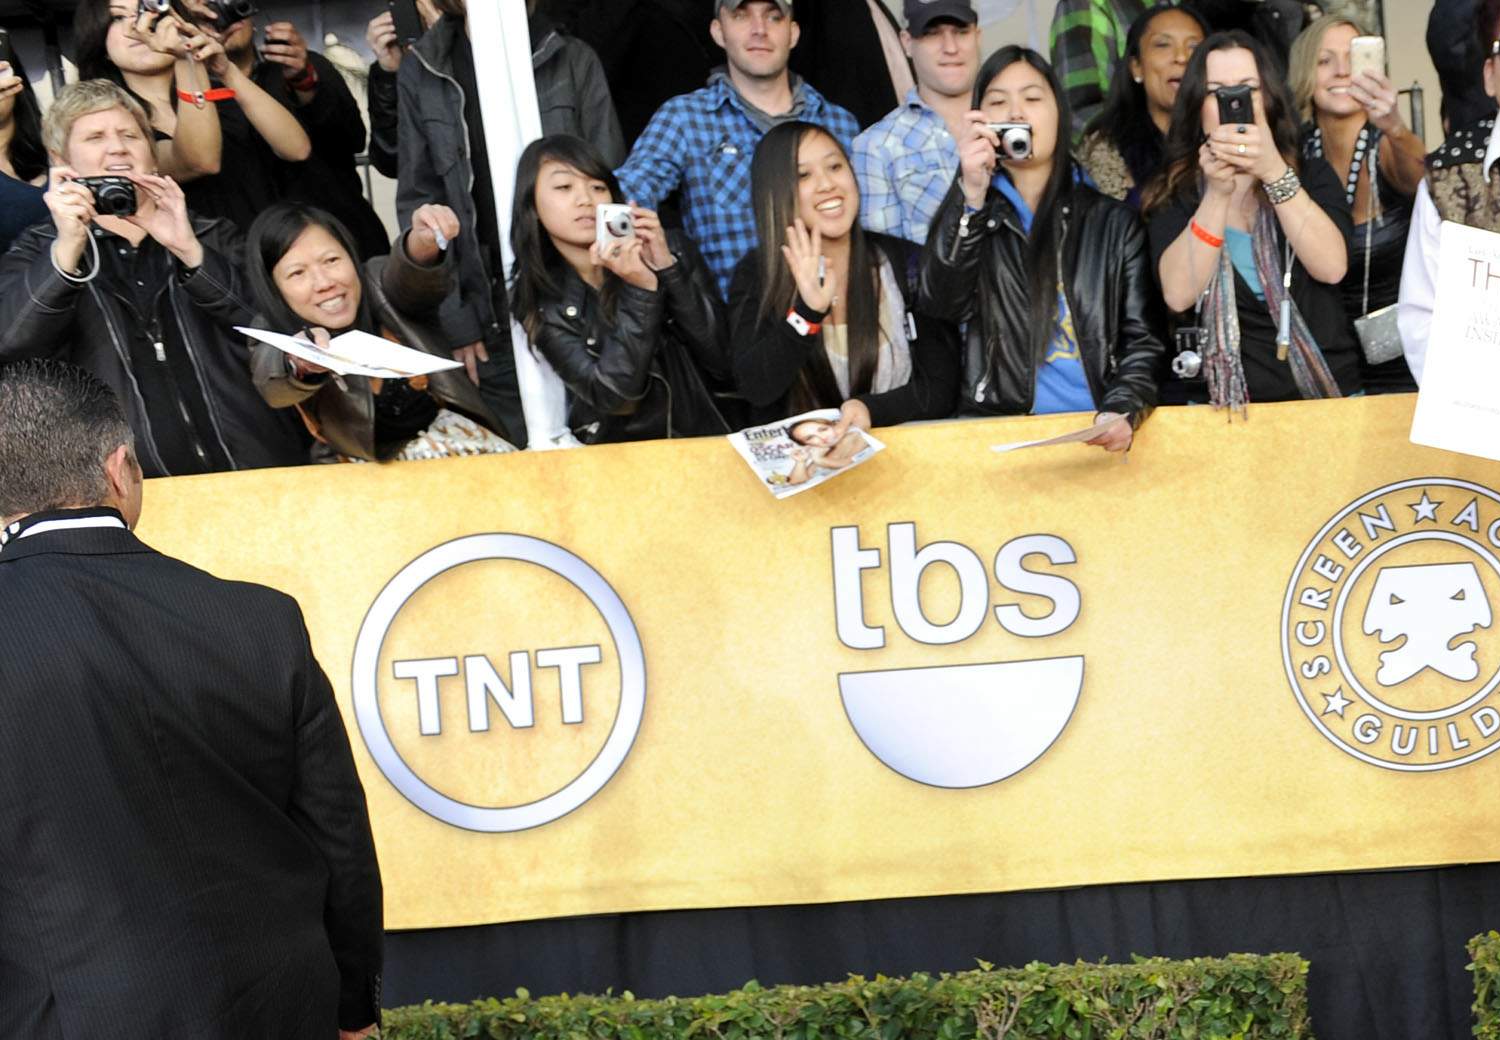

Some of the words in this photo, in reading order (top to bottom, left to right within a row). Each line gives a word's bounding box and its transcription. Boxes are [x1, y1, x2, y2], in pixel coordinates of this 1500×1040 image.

[830, 521, 1082, 651] tbs
[1296, 503, 1397, 680] SCREEN
[392, 644, 602, 737] TNT
